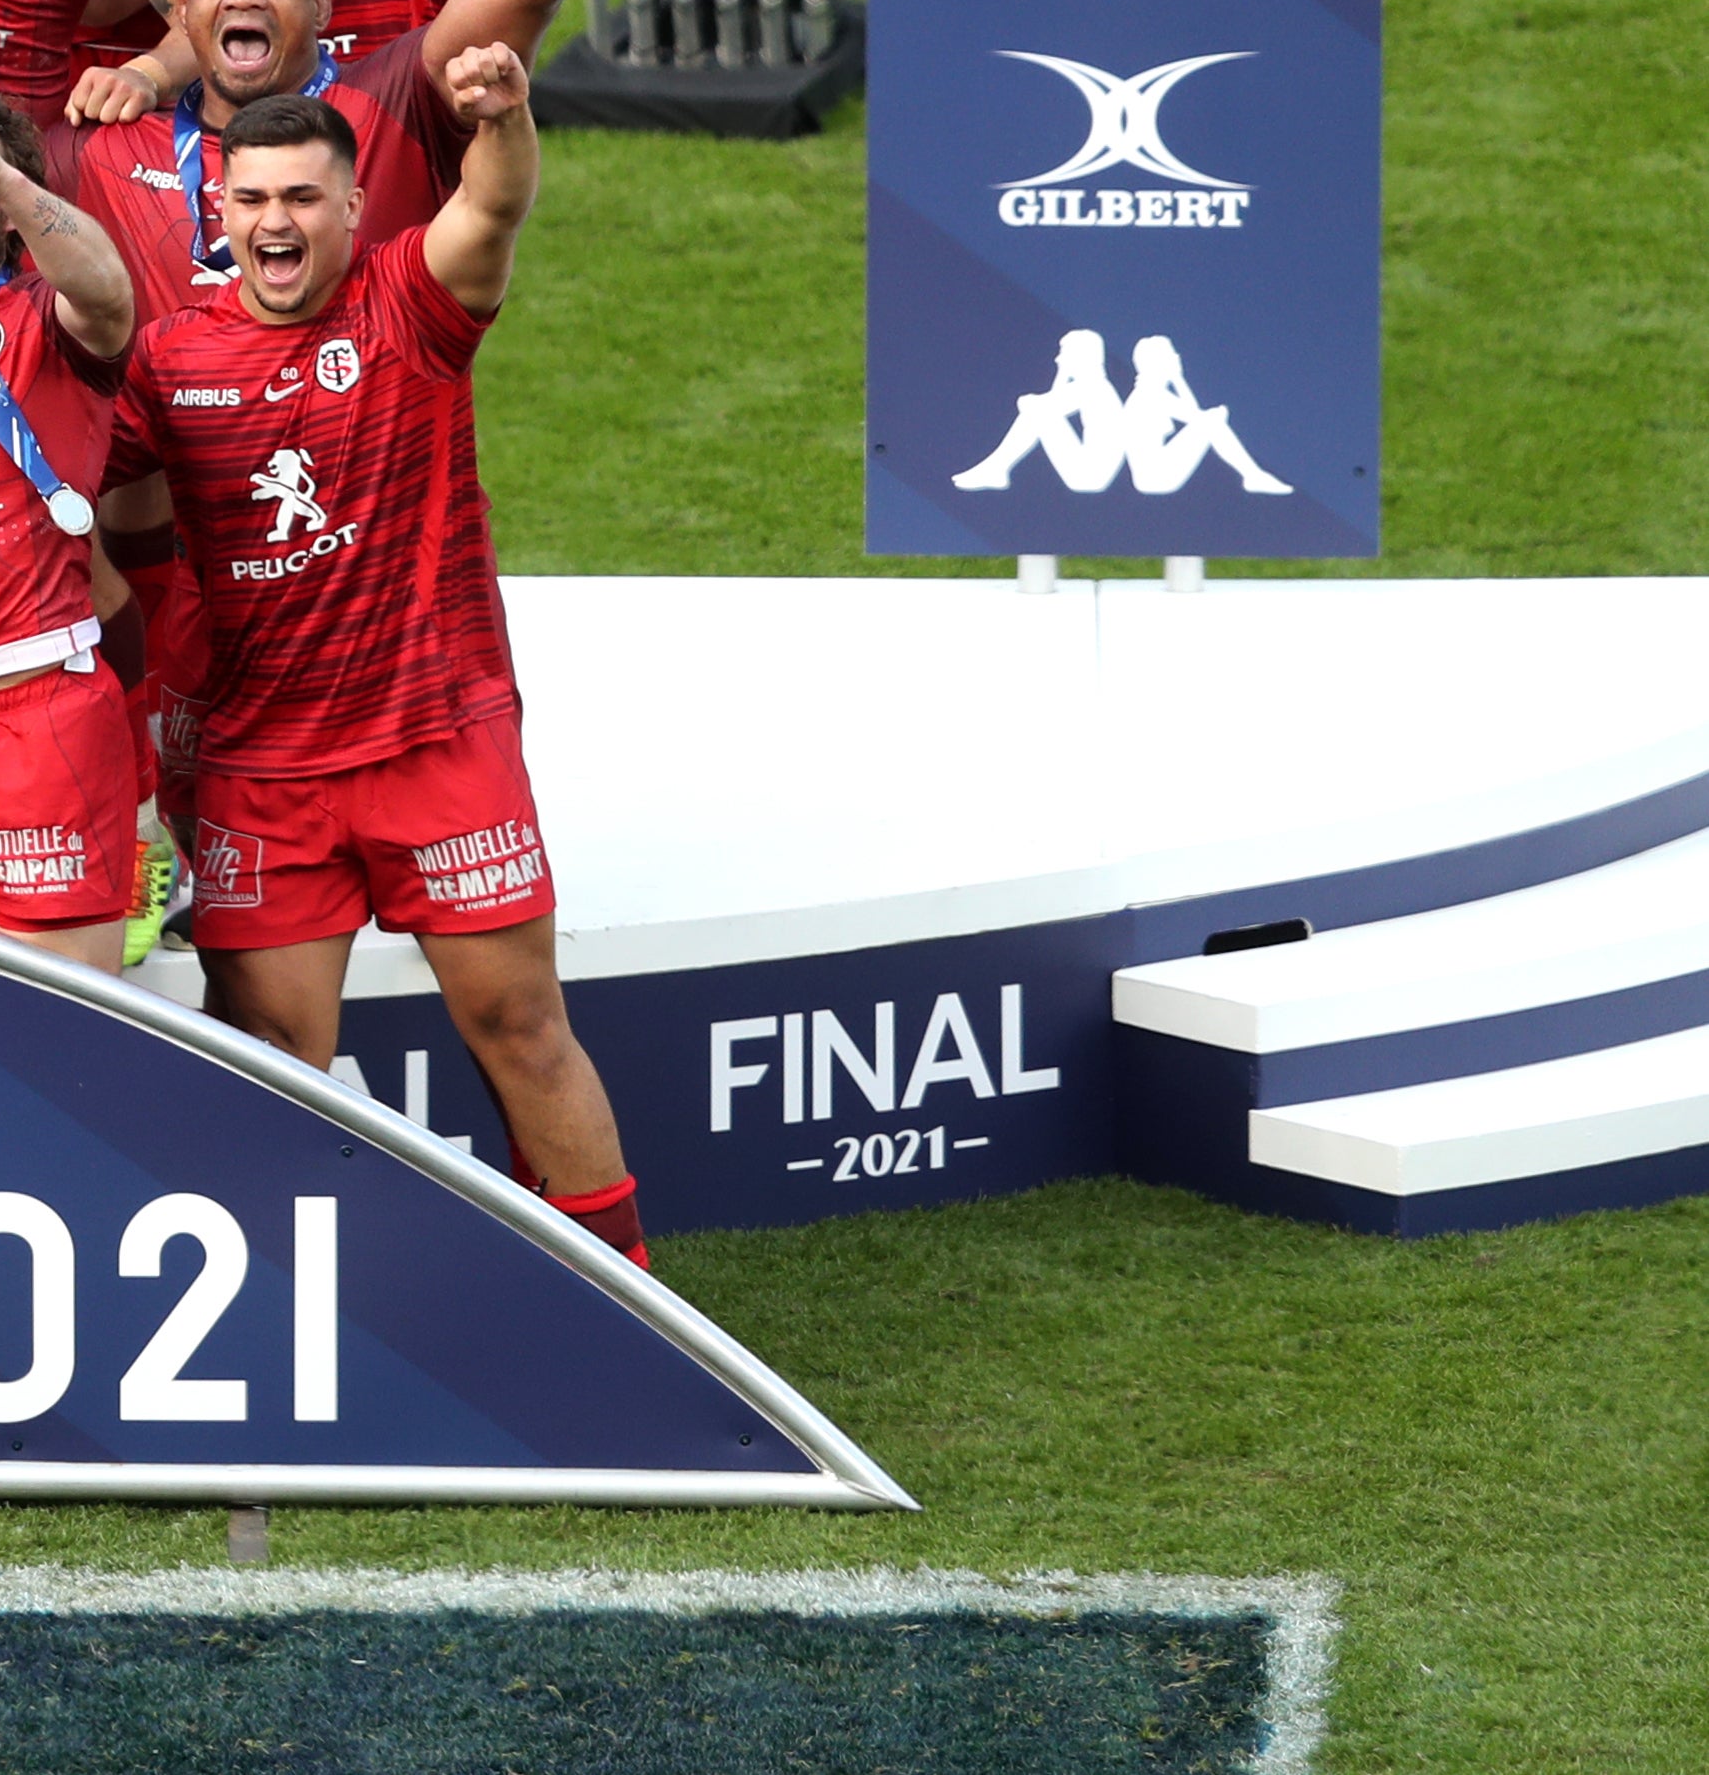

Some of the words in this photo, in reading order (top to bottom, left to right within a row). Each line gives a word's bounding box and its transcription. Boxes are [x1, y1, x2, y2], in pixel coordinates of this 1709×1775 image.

[998, 189, 1251, 229] GILBERT
[279, 366, 299, 381] 60
[171, 387, 242, 408] AIRBUS
[67, 829, 84, 851] du
[411, 819, 522, 874] MUTUELLE
[424, 847, 544, 902] REMPART
[710, 984, 1061, 1132] FINAL
[833, 1126, 945, 1183] 2021
